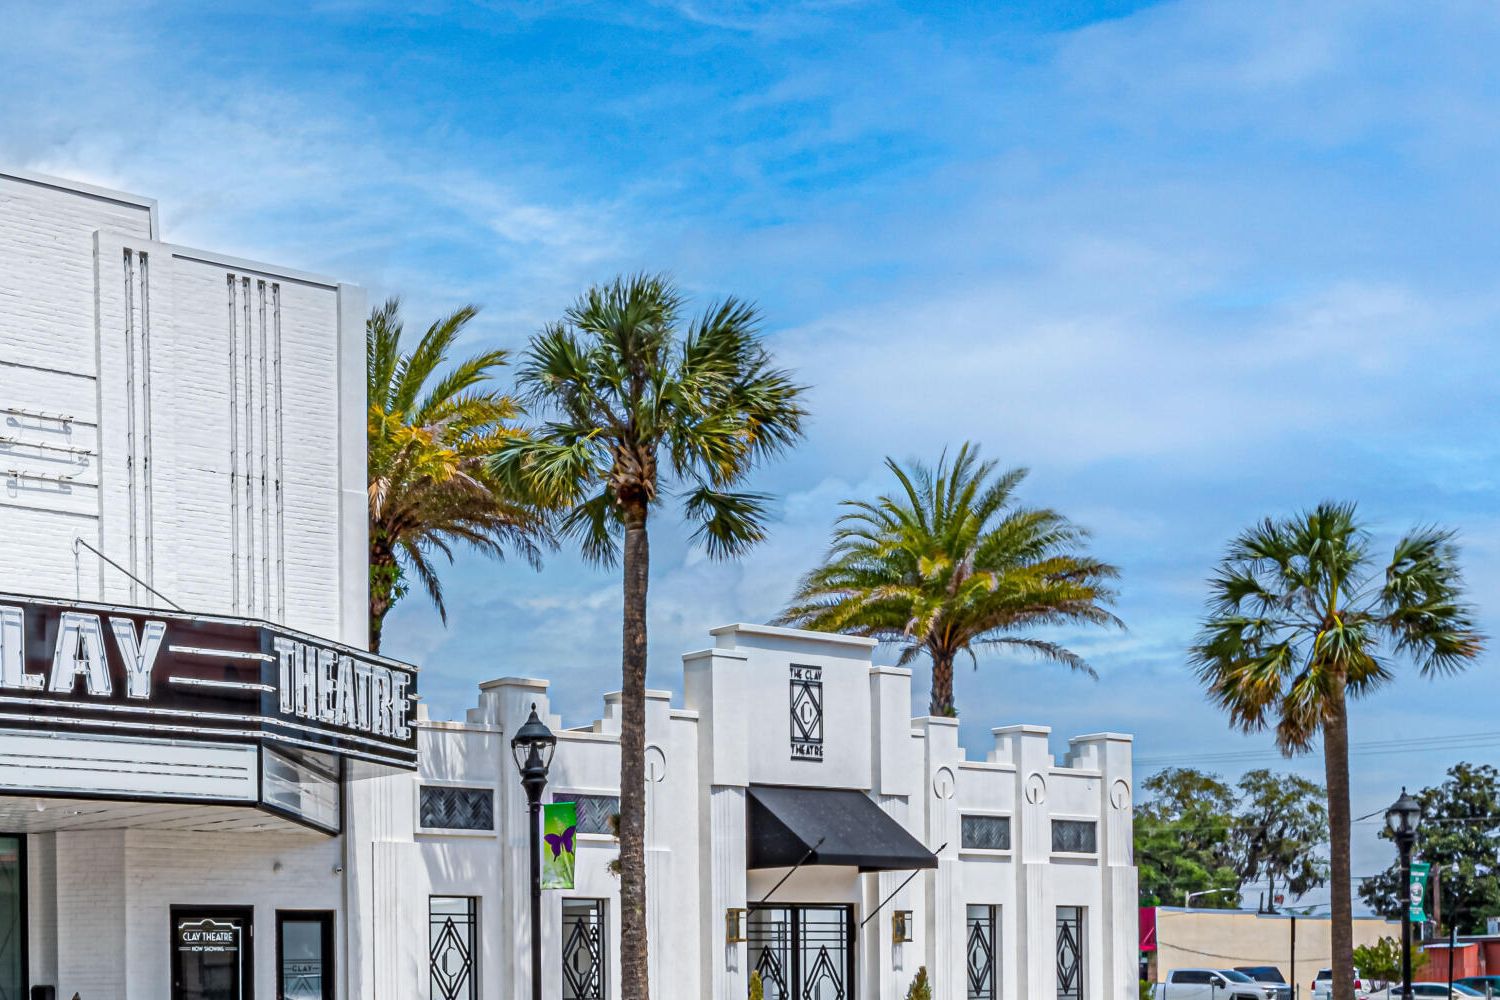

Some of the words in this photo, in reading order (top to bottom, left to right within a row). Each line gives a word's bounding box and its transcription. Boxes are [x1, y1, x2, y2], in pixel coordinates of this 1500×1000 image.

[790, 668, 802, 679] THE
[805, 669, 822, 681] CLAY
[273, 636, 412, 741] THEATRE
[790, 743, 823, 756] THEATRE
[182, 932, 200, 941] CLAY
[202, 932, 233, 941] THEATRE
